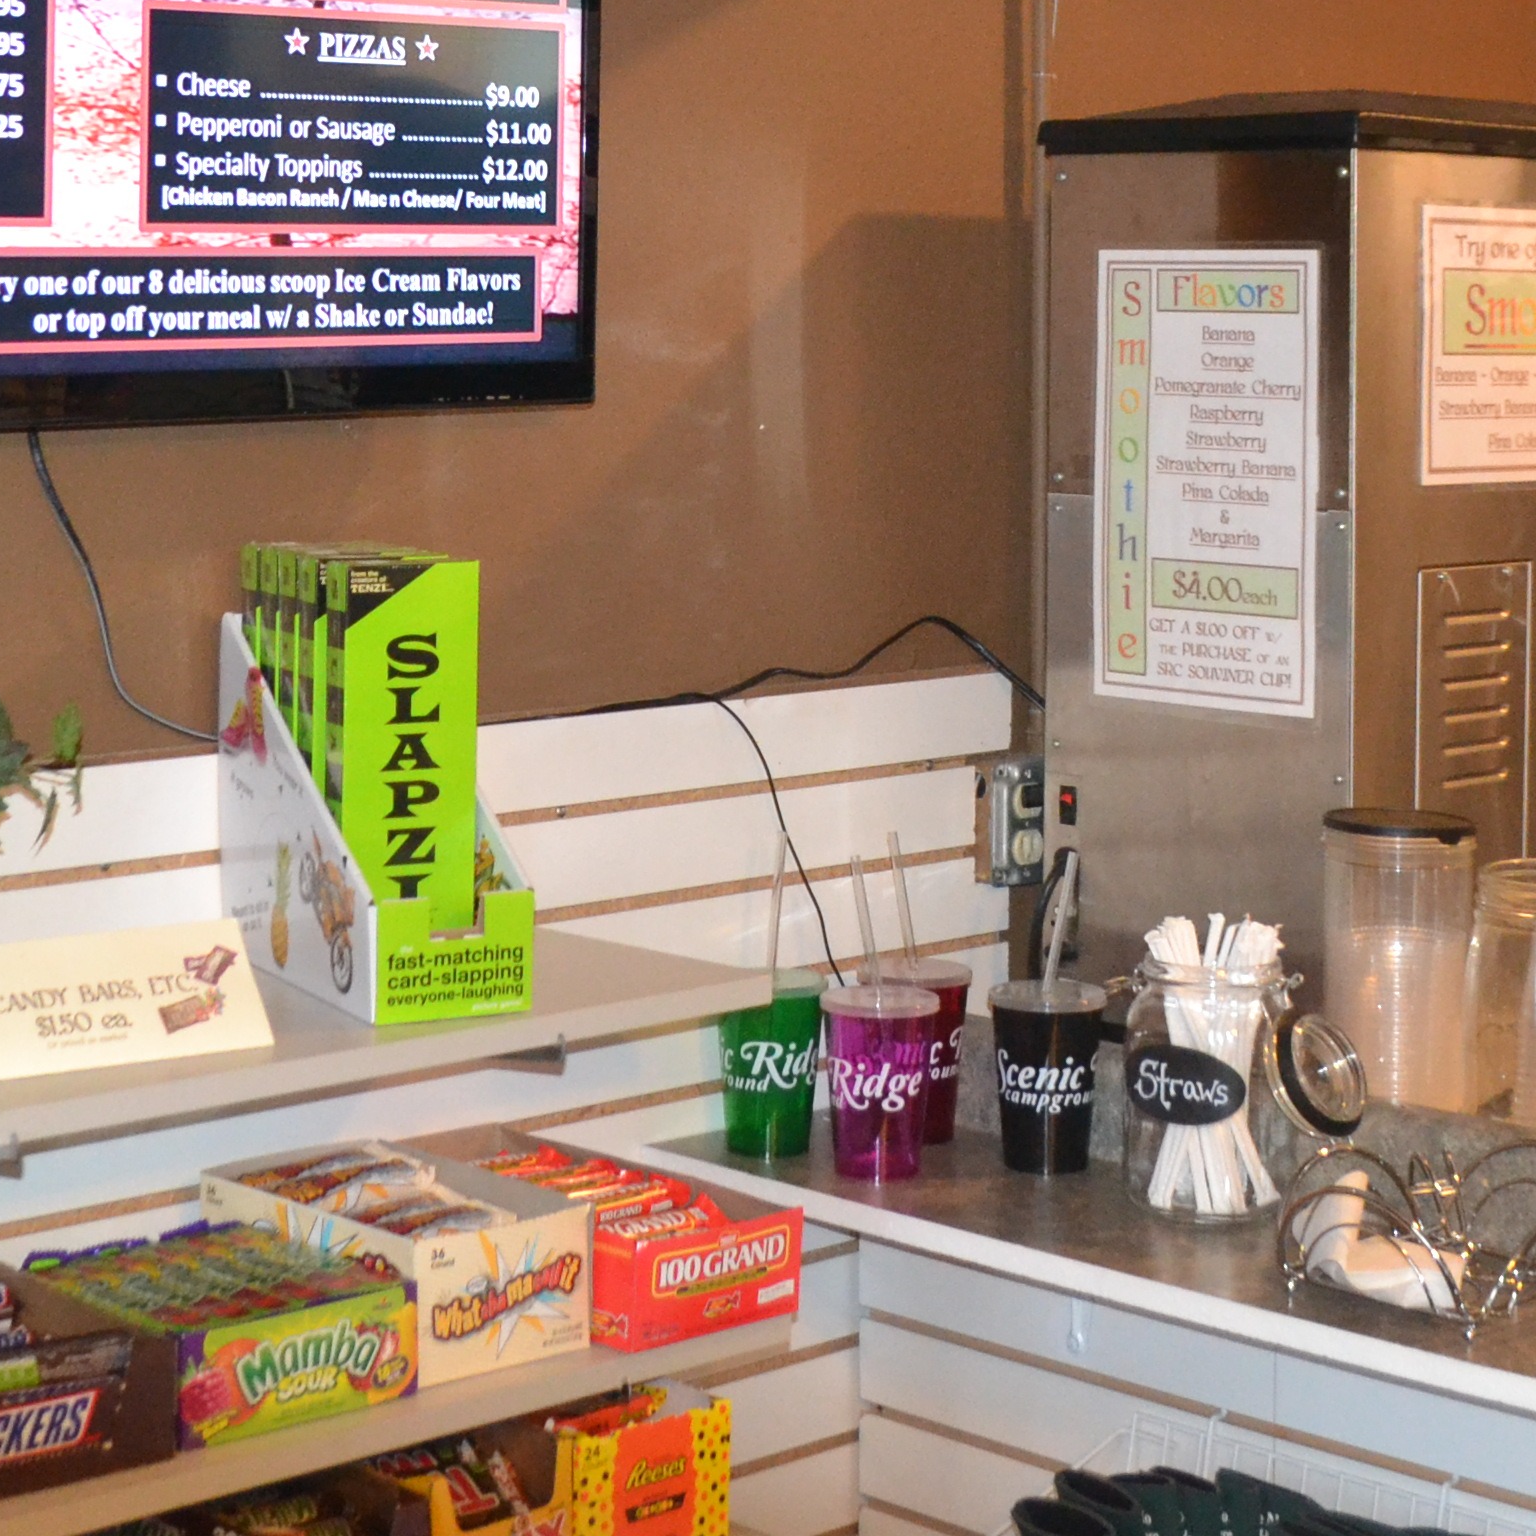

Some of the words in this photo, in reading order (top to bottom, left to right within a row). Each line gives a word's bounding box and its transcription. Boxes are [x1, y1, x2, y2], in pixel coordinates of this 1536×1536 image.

[319, 32, 406, 59] PIZZAS
[177, 72, 251, 98] Cheese
[484, 81, 540, 109] $9.00
[177, 112, 282, 142] Pepperoni
[289, 120, 311, 138] or
[316, 116, 395, 146] Sausage
[485, 121, 551, 146] $11.00
[176, 151, 270, 182] Specialty
[274, 153, 362, 187] Toppings
[482, 156, 548, 184] $12.00
[1455, 235, 1485, 265] Try
[1491, 242, 1519, 260] one
[1173, 274, 1285, 308] Flavors
[1202, 325, 1255, 343] Banana
[1201, 351, 1255, 372] Orange
[1154, 377, 1246, 398] Pomegranate
[1252, 379, 1302, 401] Cherry
[1189, 404, 1264, 427] Raspberry
[1186, 431, 1267, 454] Strawberry
[1156, 455, 1238, 478] Strawberry
[1242, 461, 1297, 479] Banana
[1219, 484, 1270, 503] Colada
[1189, 528, 1261, 549] Margarita
[380, 632, 441, 899] SLAPZI
[387, 945, 524, 971] fast-matching
[387, 965, 524, 990] card-slapping
[387, 983, 524, 1006] everyone-laughing
[827, 1056, 922, 1112] Ridge
[998, 1048, 1086, 1094] Scenic
[1133, 1057, 1229, 1112] Straws
[658, 1253, 703, 1289] 100
[702, 1233, 786, 1278] GRAND
[236, 1318, 381, 1406] Mamba
[275, 1365, 340, 1403] SOUR
